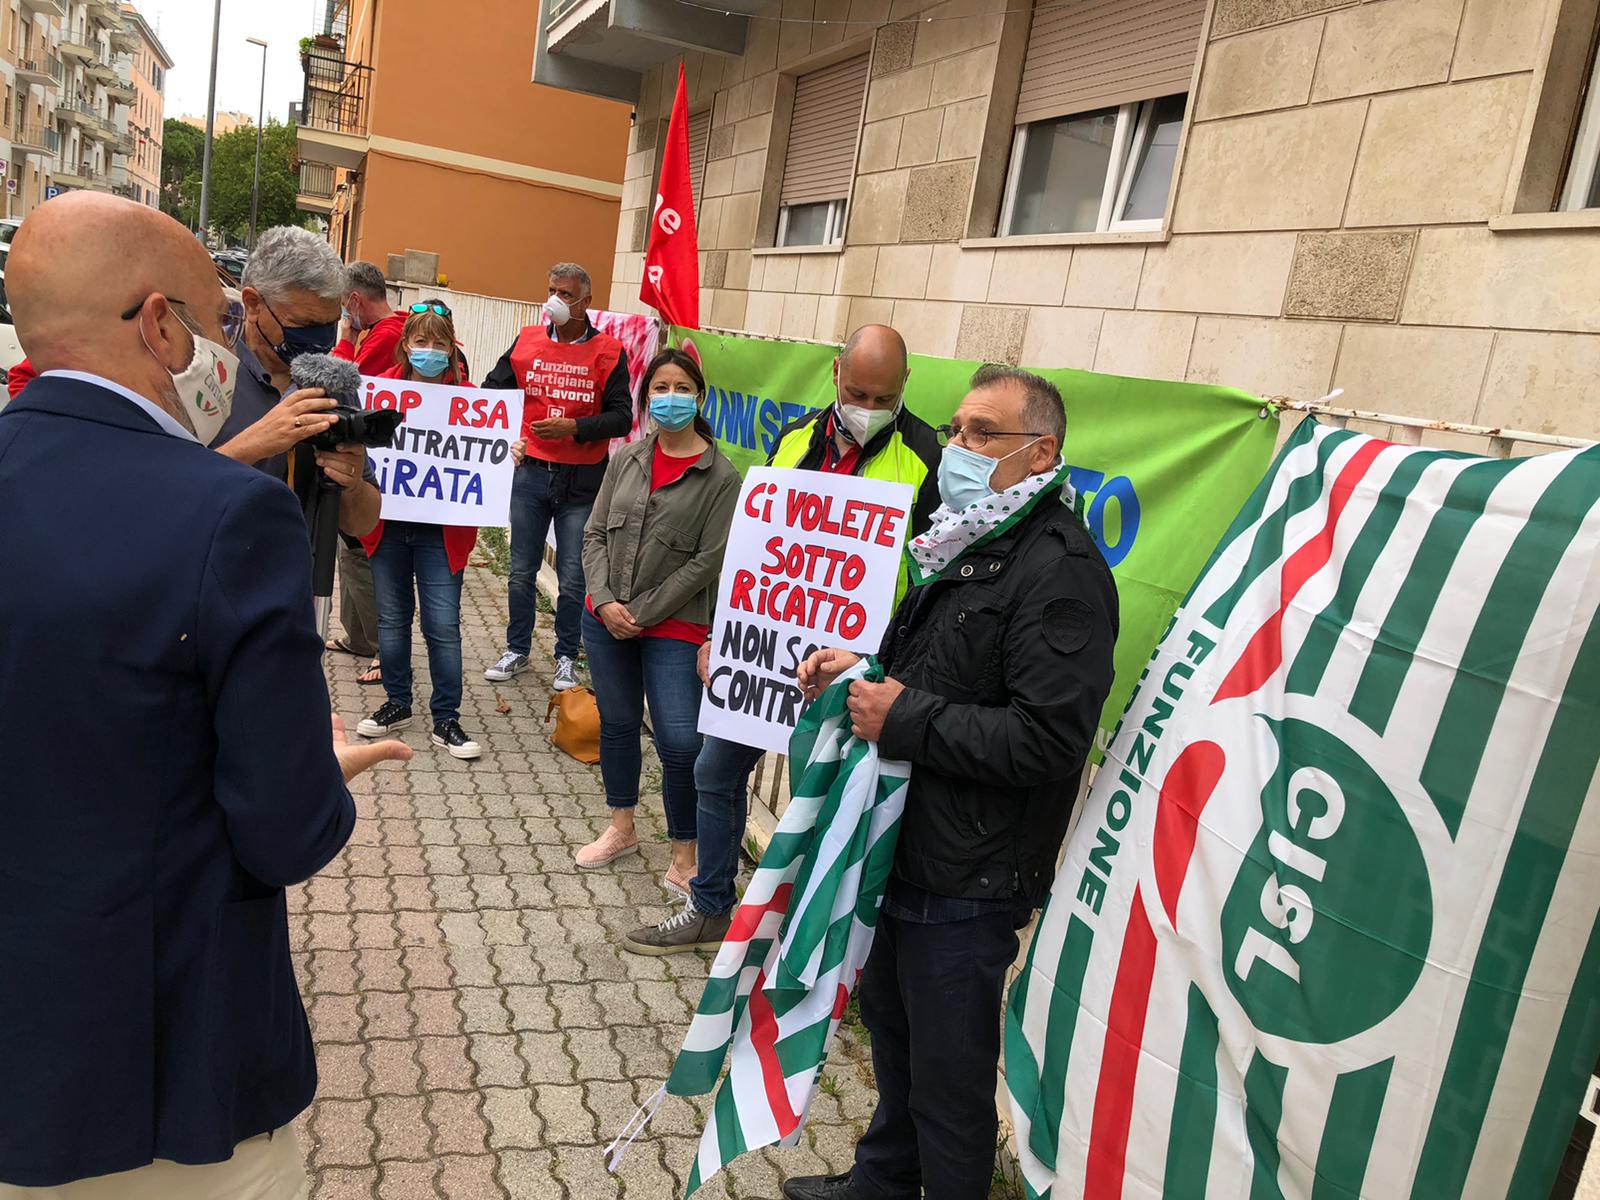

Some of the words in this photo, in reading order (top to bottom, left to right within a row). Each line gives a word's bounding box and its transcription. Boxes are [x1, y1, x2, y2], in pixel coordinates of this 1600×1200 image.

[48, 188, 58, 199] P
[526, 371, 594, 389] Partigiana
[533, 359, 589, 375] Funzione
[365, 382, 422, 423] iOP
[448, 396, 509, 429] RSA
[526, 385, 542, 396] dei
[546, 386, 595, 403] Lavoro!
[702, 385, 758, 450] ANNI
[391, 426, 509, 465] NTRATTO
[744, 482, 778, 523] Ci
[786, 488, 905, 548] VOLETE
[761, 536, 866, 591] SOTTO
[729, 569, 867, 640] RiCATTO
[719, 620, 779, 671] NON
[1076, 629, 1217, 916] FUNZIONE
[1234, 766, 1346, 984] CISL
